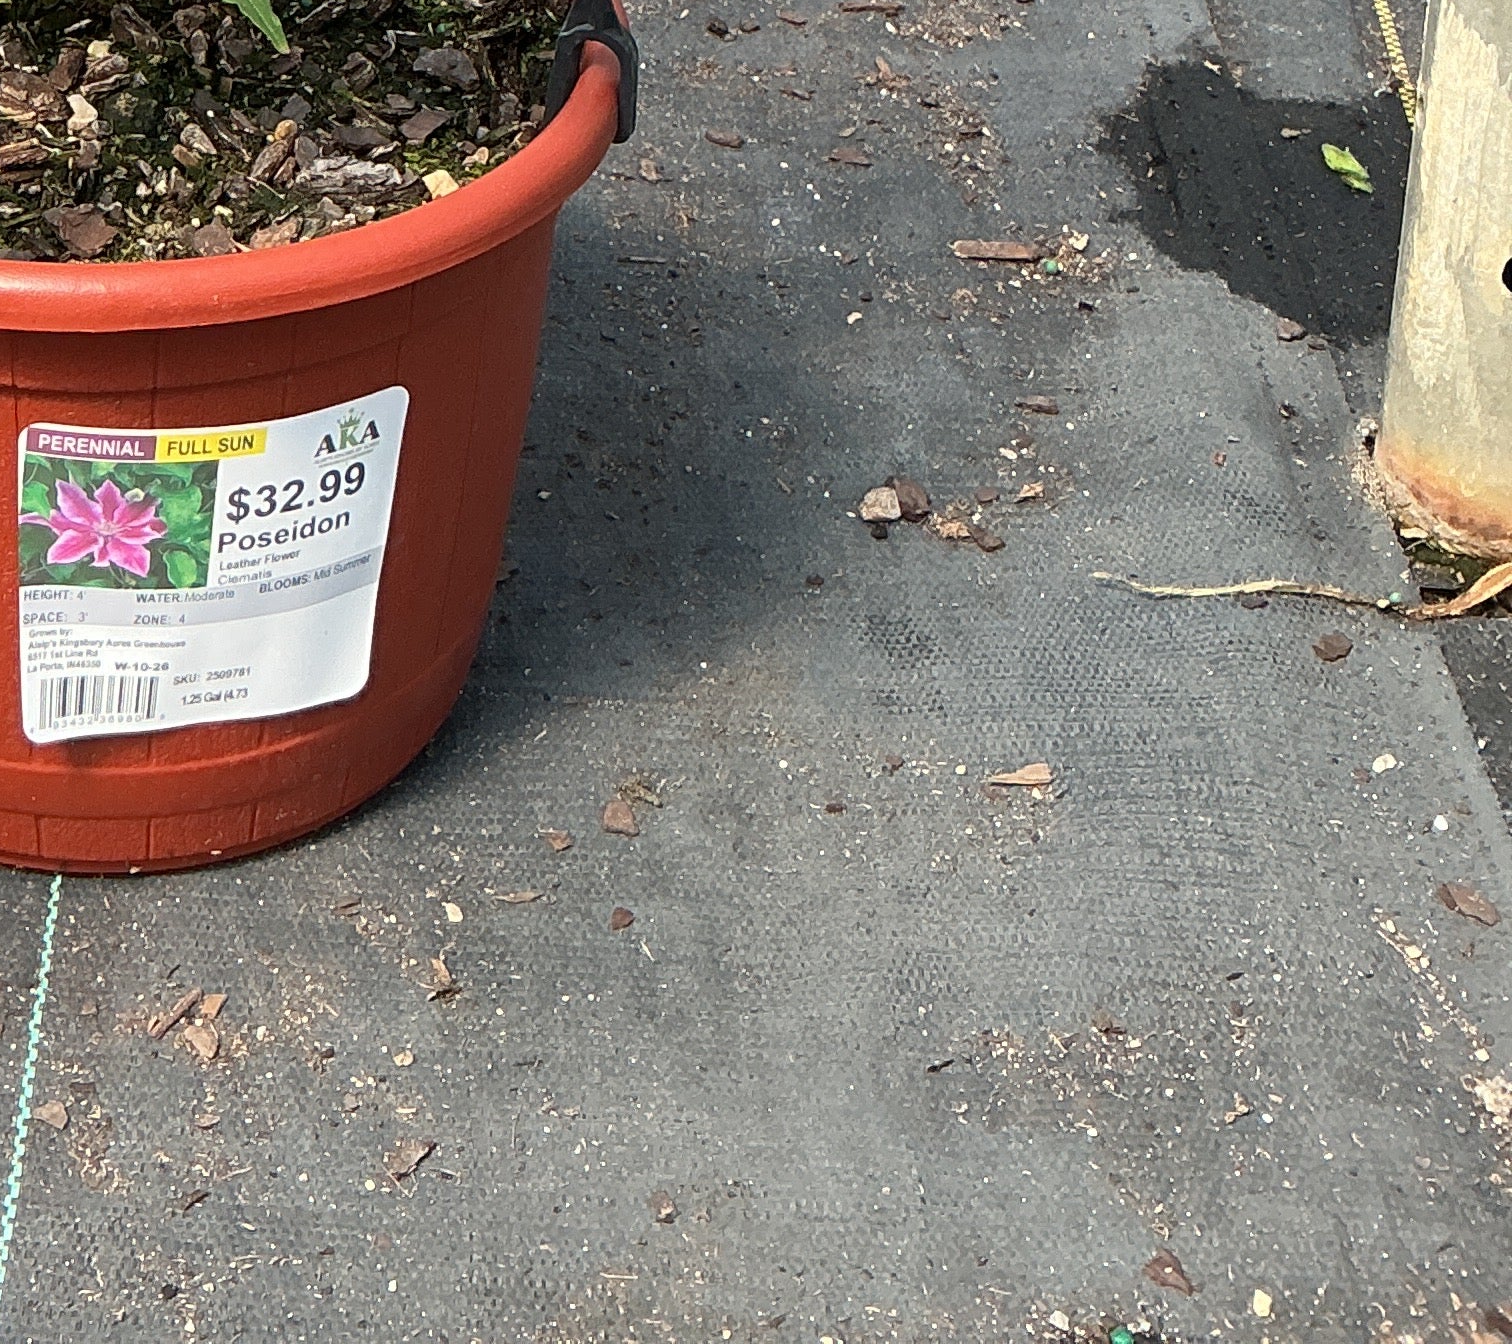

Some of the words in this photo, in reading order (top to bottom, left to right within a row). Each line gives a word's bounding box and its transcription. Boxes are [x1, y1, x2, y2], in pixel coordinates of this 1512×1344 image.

[38, 433, 145, 457] PERENNIAL
[167, 440, 212, 457] FULL
[218, 434, 254, 453] SUN
[314, 420, 380, 458] AKA
[226, 461, 366, 525] $32.99
[218, 512, 350, 554] Poseidon
[219, 555, 263, 571] Leather
[264, 549, 301, 564] Flower
[218, 569, 273, 586] Clematis
[259, 574, 312, 594] BLOOMS:
[314, 568, 332, 581] Mid
[333, 554, 372, 575] Summer
[184, 589, 235, 603] Moderate
[178, 614, 185, 624] 4
[115, 661, 170, 672] W-10-26
